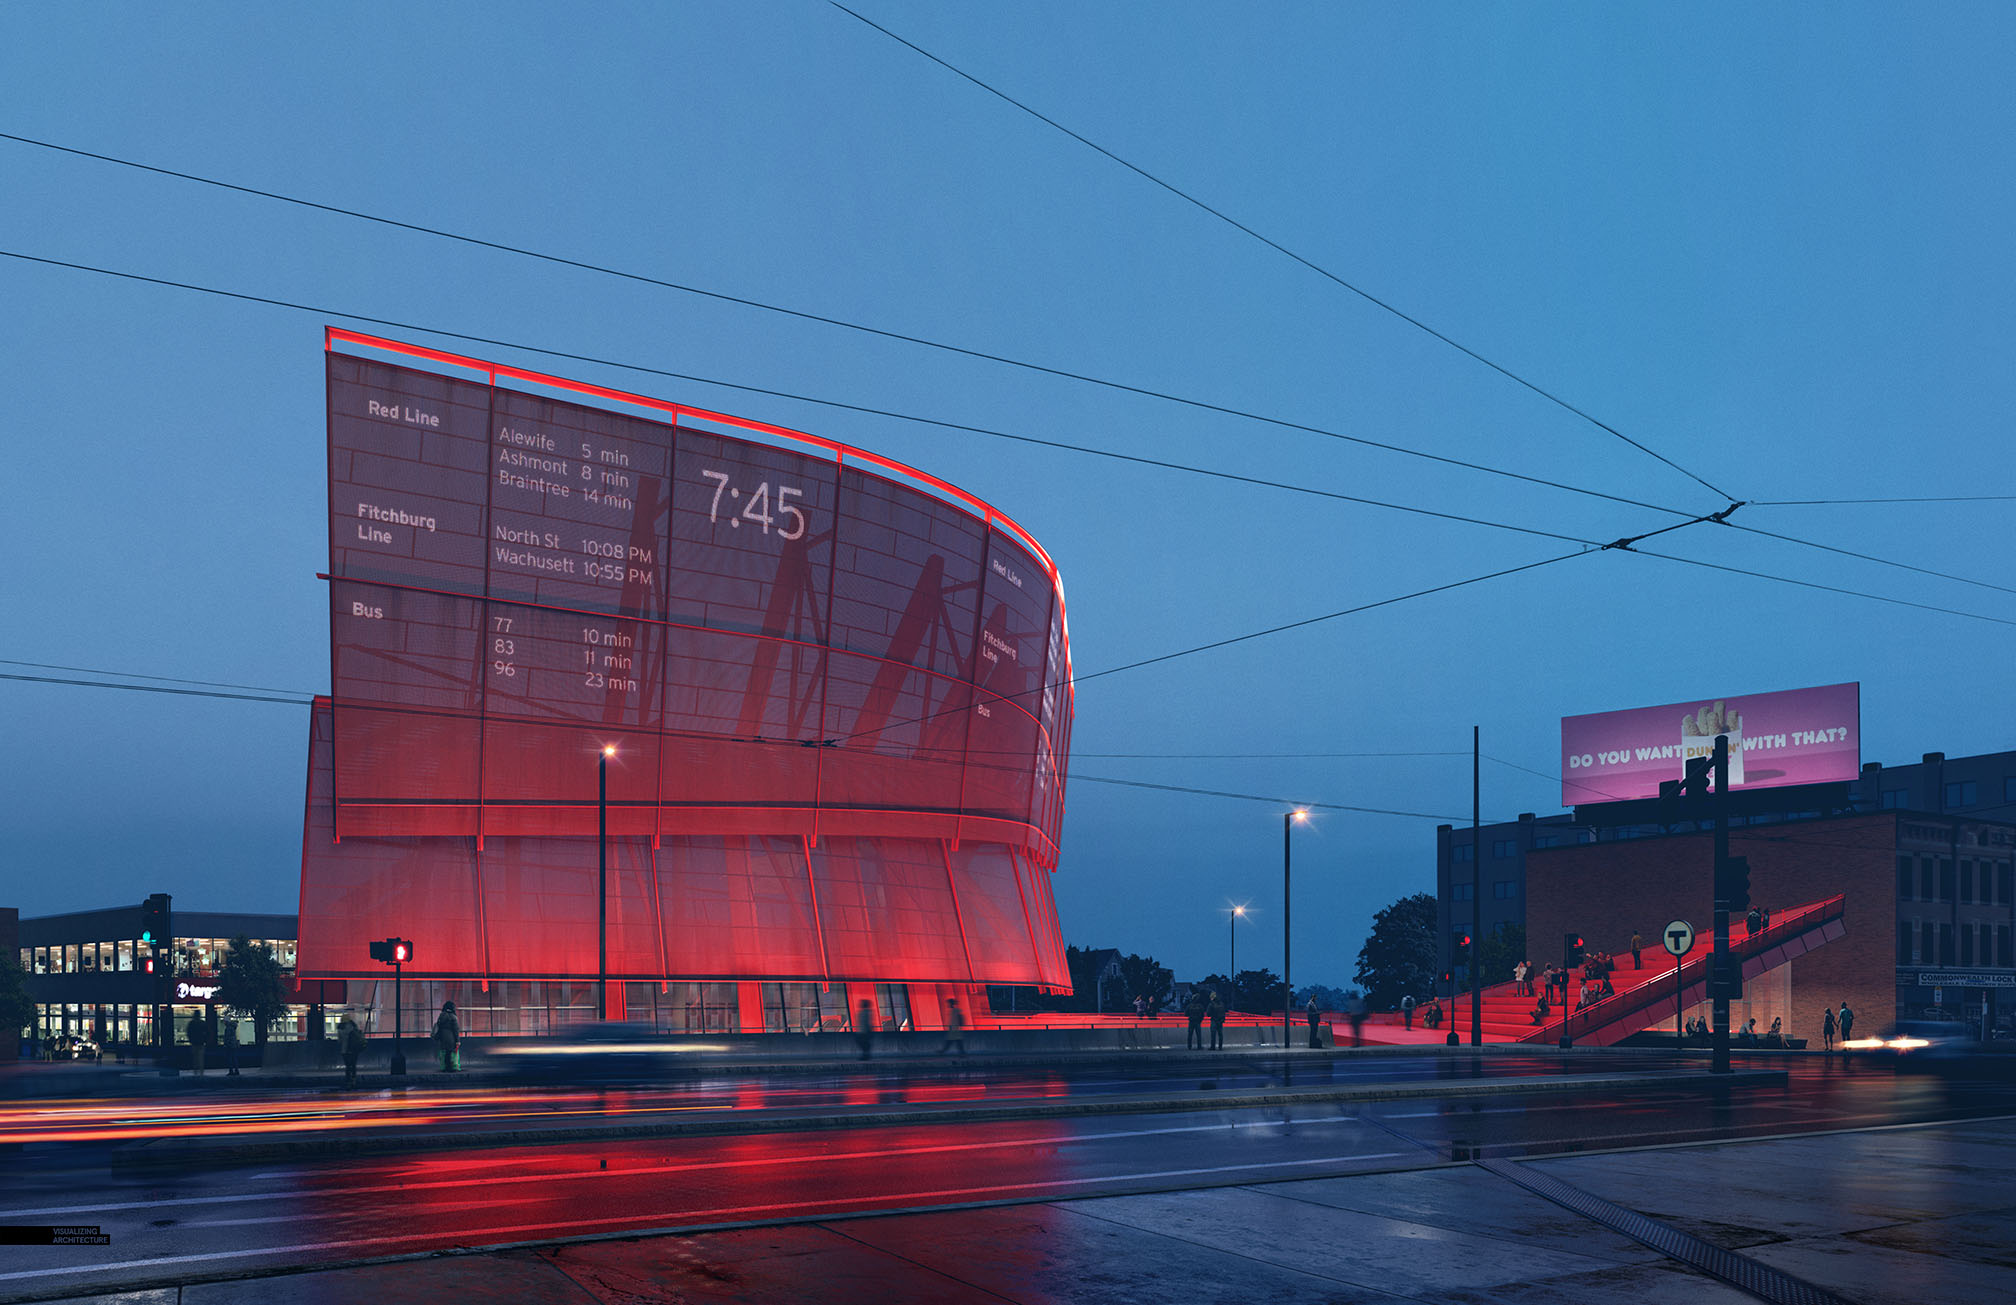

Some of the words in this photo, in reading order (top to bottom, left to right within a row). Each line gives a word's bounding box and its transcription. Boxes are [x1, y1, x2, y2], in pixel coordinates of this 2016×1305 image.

[369, 400, 399, 419] Red
[405, 407, 440, 427] Line
[499, 427, 555, 451] Alewife
[581, 443, 592, 459] 5
[601, 449, 629, 466] min
[499, 449, 568, 476] Ashmont
[581, 465, 592, 481] 8
[601, 471, 629, 488] min
[499, 470, 570, 497] Braintree
[583, 487, 599, 504] 14
[604, 493, 632, 510] min
[358, 503, 436, 532] Fitchburg
[702, 469, 805, 541] 7:45
[358, 524, 393, 544] Line
[496, 525, 540, 546] North
[544, 533, 560, 549] St
[582, 539, 624, 559] 10:08
[629, 547, 652, 564] PM
[496, 547, 575, 573] Wachusett
[584, 561, 624, 581] 10:55
[629, 568, 652, 585] PM
[993, 559, 1007, 576] Red
[1007, 568, 1022, 588] Line
[352, 601, 384, 619] Bus
[494, 616, 513, 633] 77
[583, 628, 599, 644] 10
[603, 632, 632, 648] min
[983, 630, 1017, 660] Fitchburg
[494, 638, 514, 655] 83
[584, 650, 595, 665] 11
[604, 654, 632, 670] min
[982, 645, 998, 664] Line
[494, 660, 515, 677] 96
[585, 672, 604, 688] 23
[608, 676, 637, 692] min
[977, 703, 991, 718] Bus
[1686, 742, 1740, 757] DUNN'
[1742, 734, 1786, 751] WITH
[1791, 727, 1848, 746] THAT?
[1569, 754, 1593, 769] DO
[1598, 749, 1630, 765] YOU
[1635, 744, 1683, 761] WANT
[1668, 930, 1687, 950] T
[1992, 975, 2013, 983] LOCK
